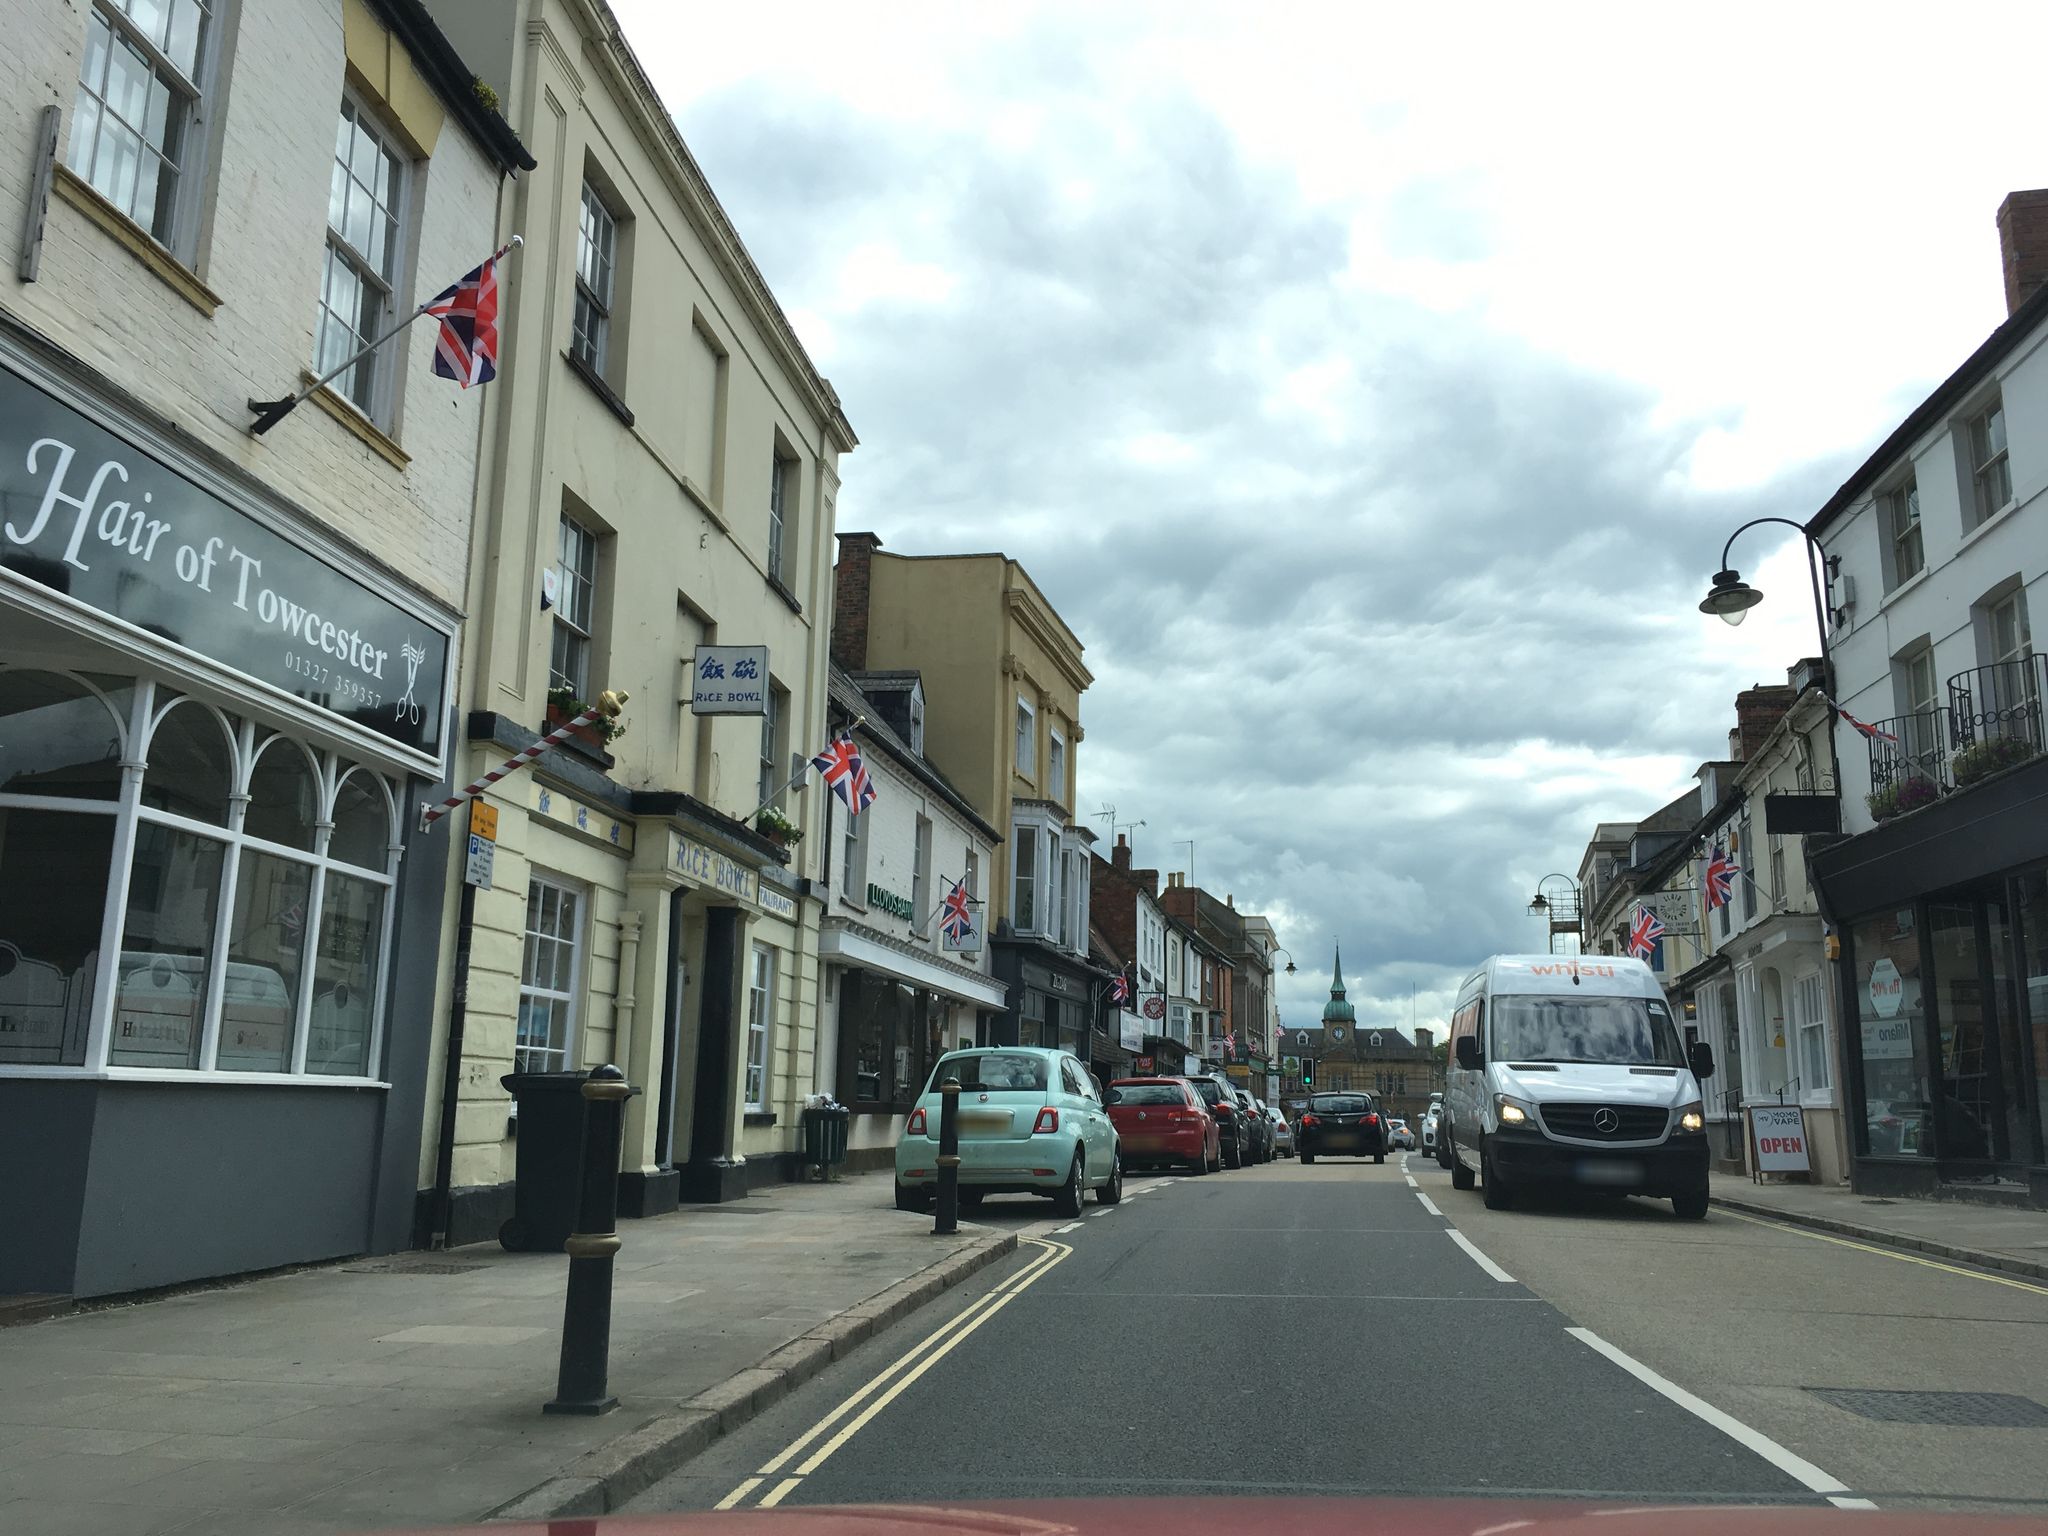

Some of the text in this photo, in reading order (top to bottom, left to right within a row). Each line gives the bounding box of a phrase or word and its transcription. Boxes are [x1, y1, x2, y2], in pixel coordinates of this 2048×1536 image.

[5, 437, 389, 681] Hair of Towcester
[284, 650, 382, 710] 01327 359357
[695, 692, 762, 702] RICE BOWL
[676, 838, 751, 898] RICE BOWL
[871, 884, 898, 913] LLOYDS
[1530, 960, 1615, 977] whistl
[1871, 978, 1901, 998] 20% off
[1760, 1137, 1802, 1154] OPEN
